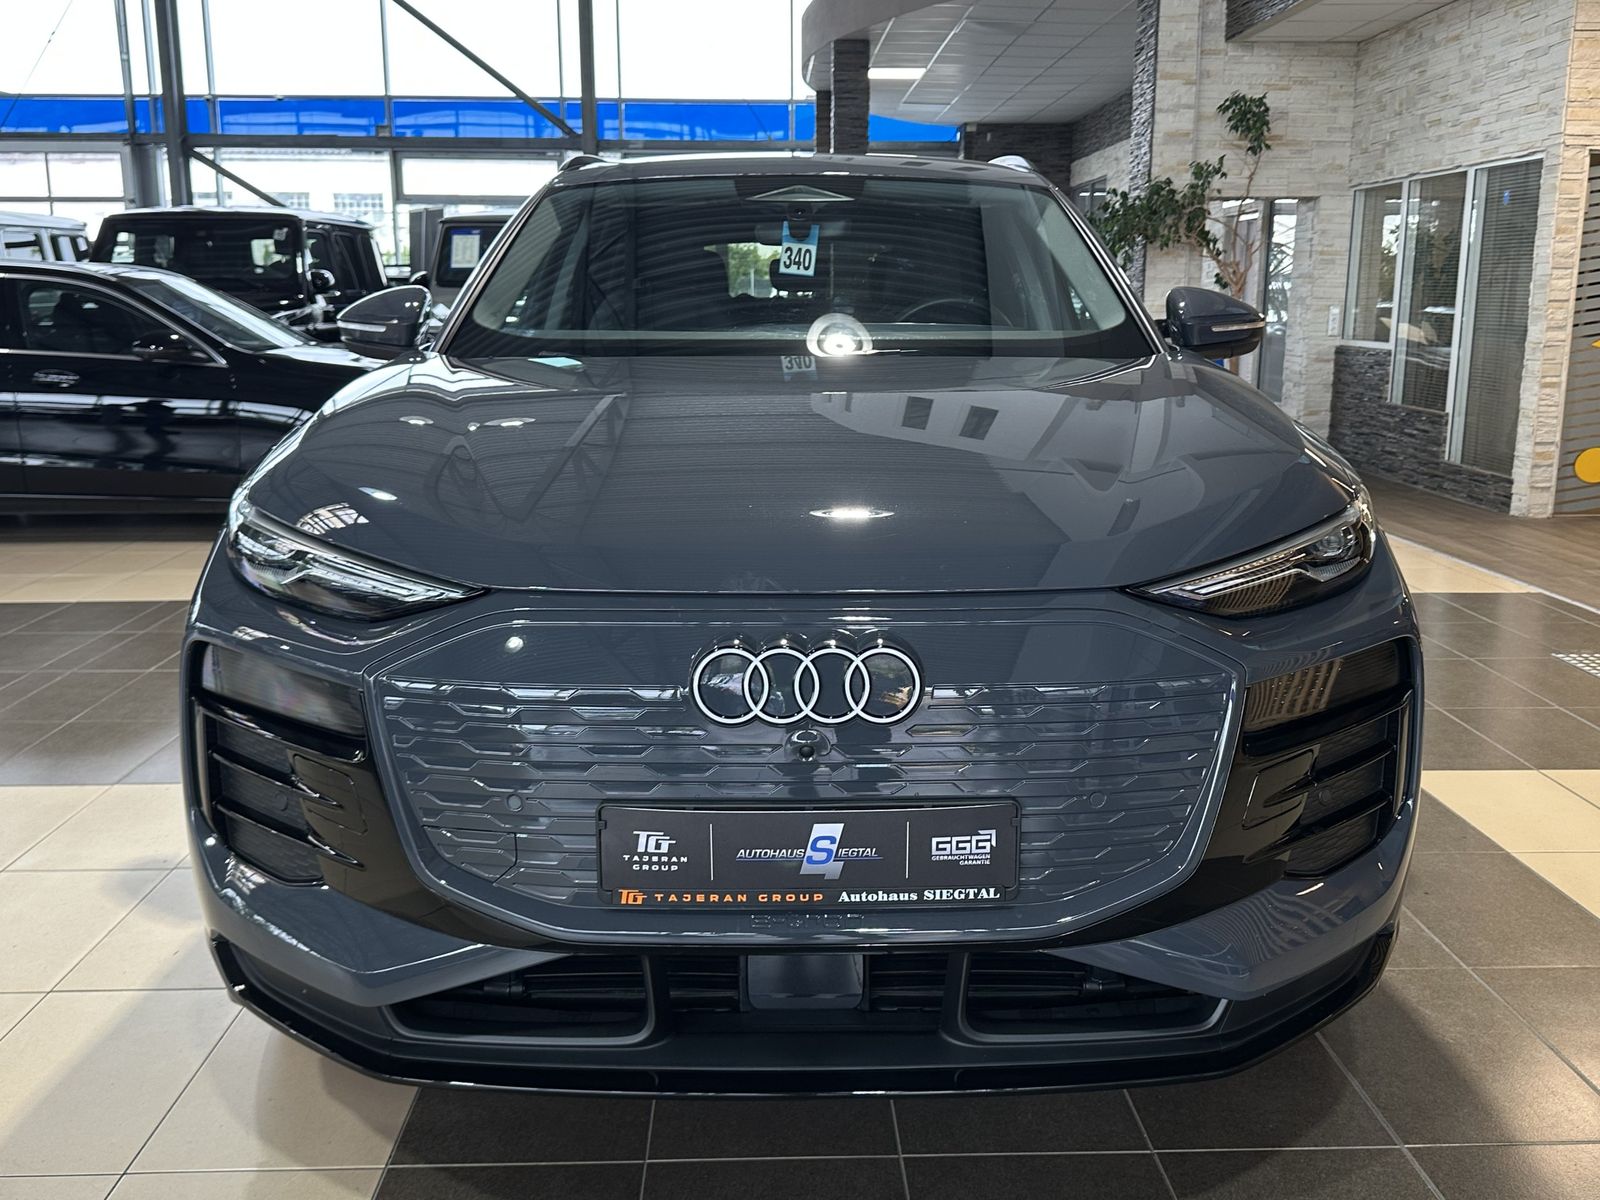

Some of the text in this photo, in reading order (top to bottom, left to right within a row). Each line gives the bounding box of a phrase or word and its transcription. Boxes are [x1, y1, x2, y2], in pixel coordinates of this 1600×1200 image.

[783, 247, 812, 271] 340
[931, 834, 991, 855] GGG
[622, 855, 688, 863] TAJERAN
[736, 849, 805, 858] AUTOHAUS
[655, 893, 747, 902] TAJERAN
[758, 893, 824, 902] GROUP
[838, 890, 918, 903] Autohaus
[923, 887, 1000, 901] SIEGTAL
